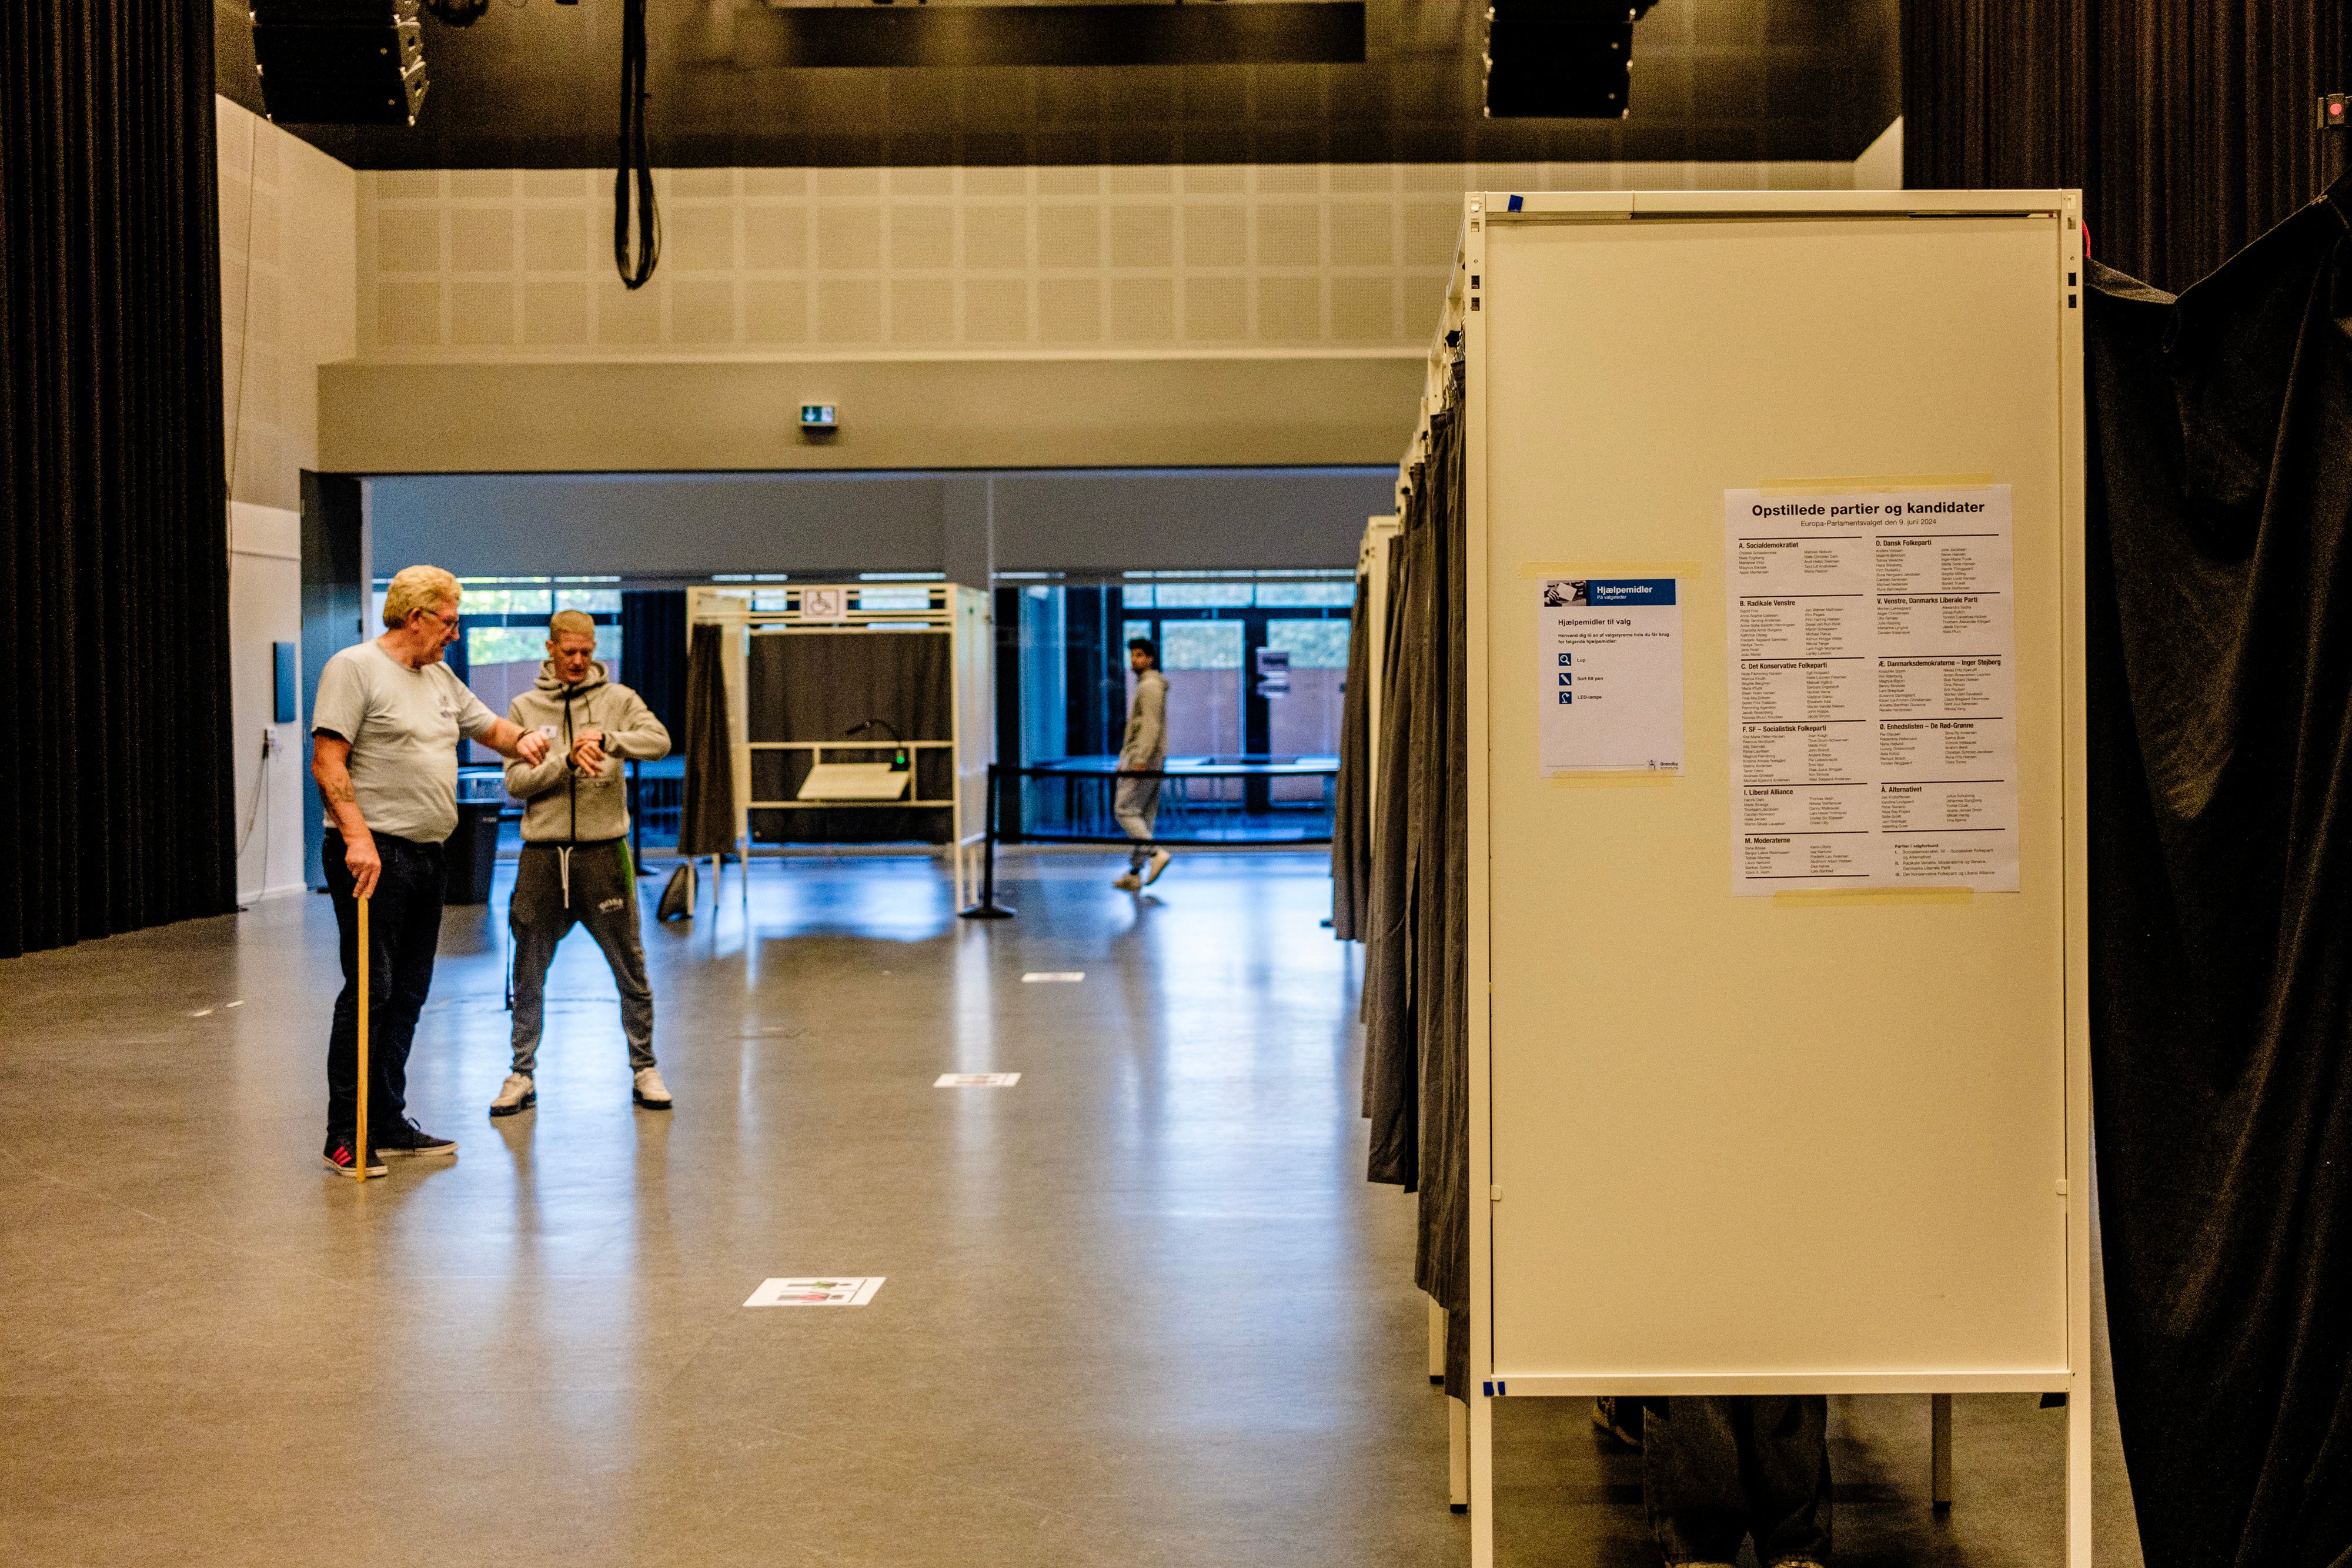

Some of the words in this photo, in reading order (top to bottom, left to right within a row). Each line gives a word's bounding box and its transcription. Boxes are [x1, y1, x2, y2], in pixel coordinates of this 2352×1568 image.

[1752, 504, 1825, 518] Opstillede
[1831, 503, 1879, 517] partier
[1885, 506, 1902, 516] og
[1907, 502, 1984, 513] kandidater
[1597, 586, 1652, 595] Hjælpemidler
